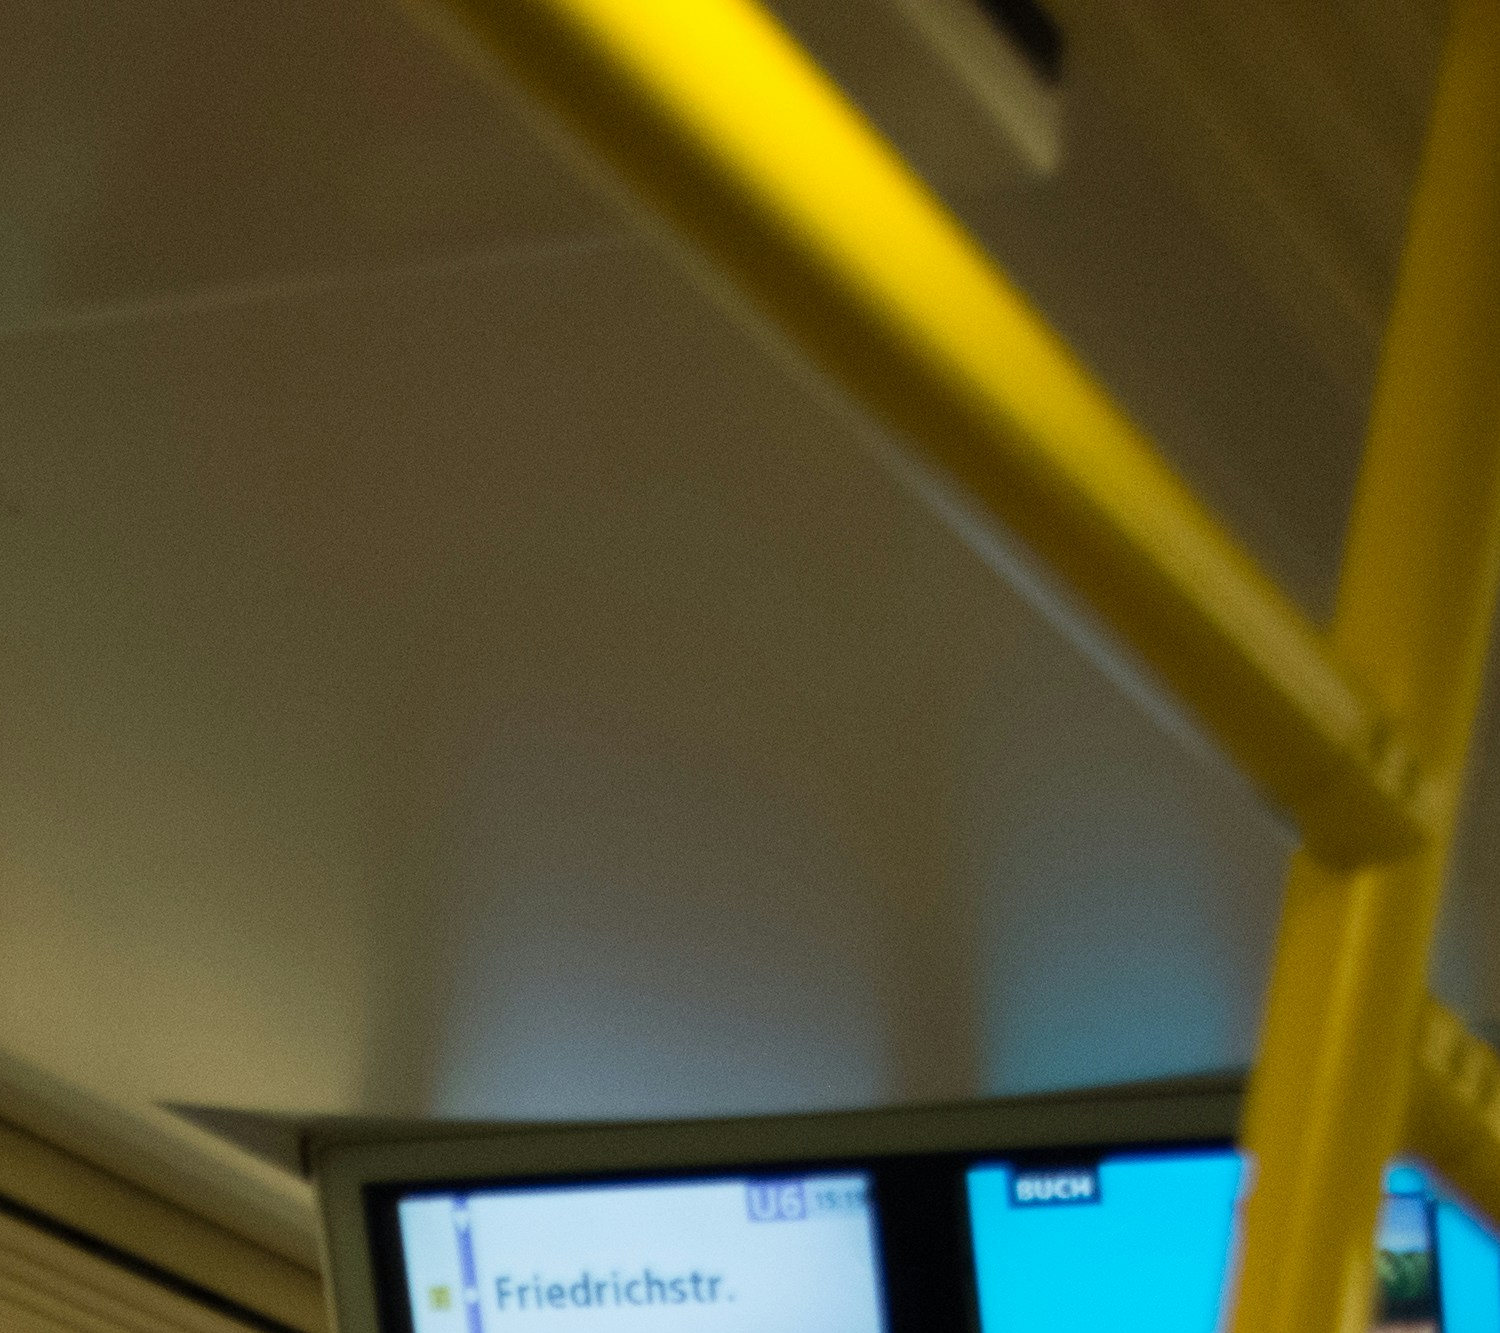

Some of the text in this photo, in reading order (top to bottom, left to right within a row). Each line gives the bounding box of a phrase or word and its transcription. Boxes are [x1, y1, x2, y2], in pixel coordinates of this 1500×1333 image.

[750, 1184, 803, 1219] U6
[1016, 1175, 1093, 1201] BUCH
[496, 1267, 736, 1311] Friedrichstr.
